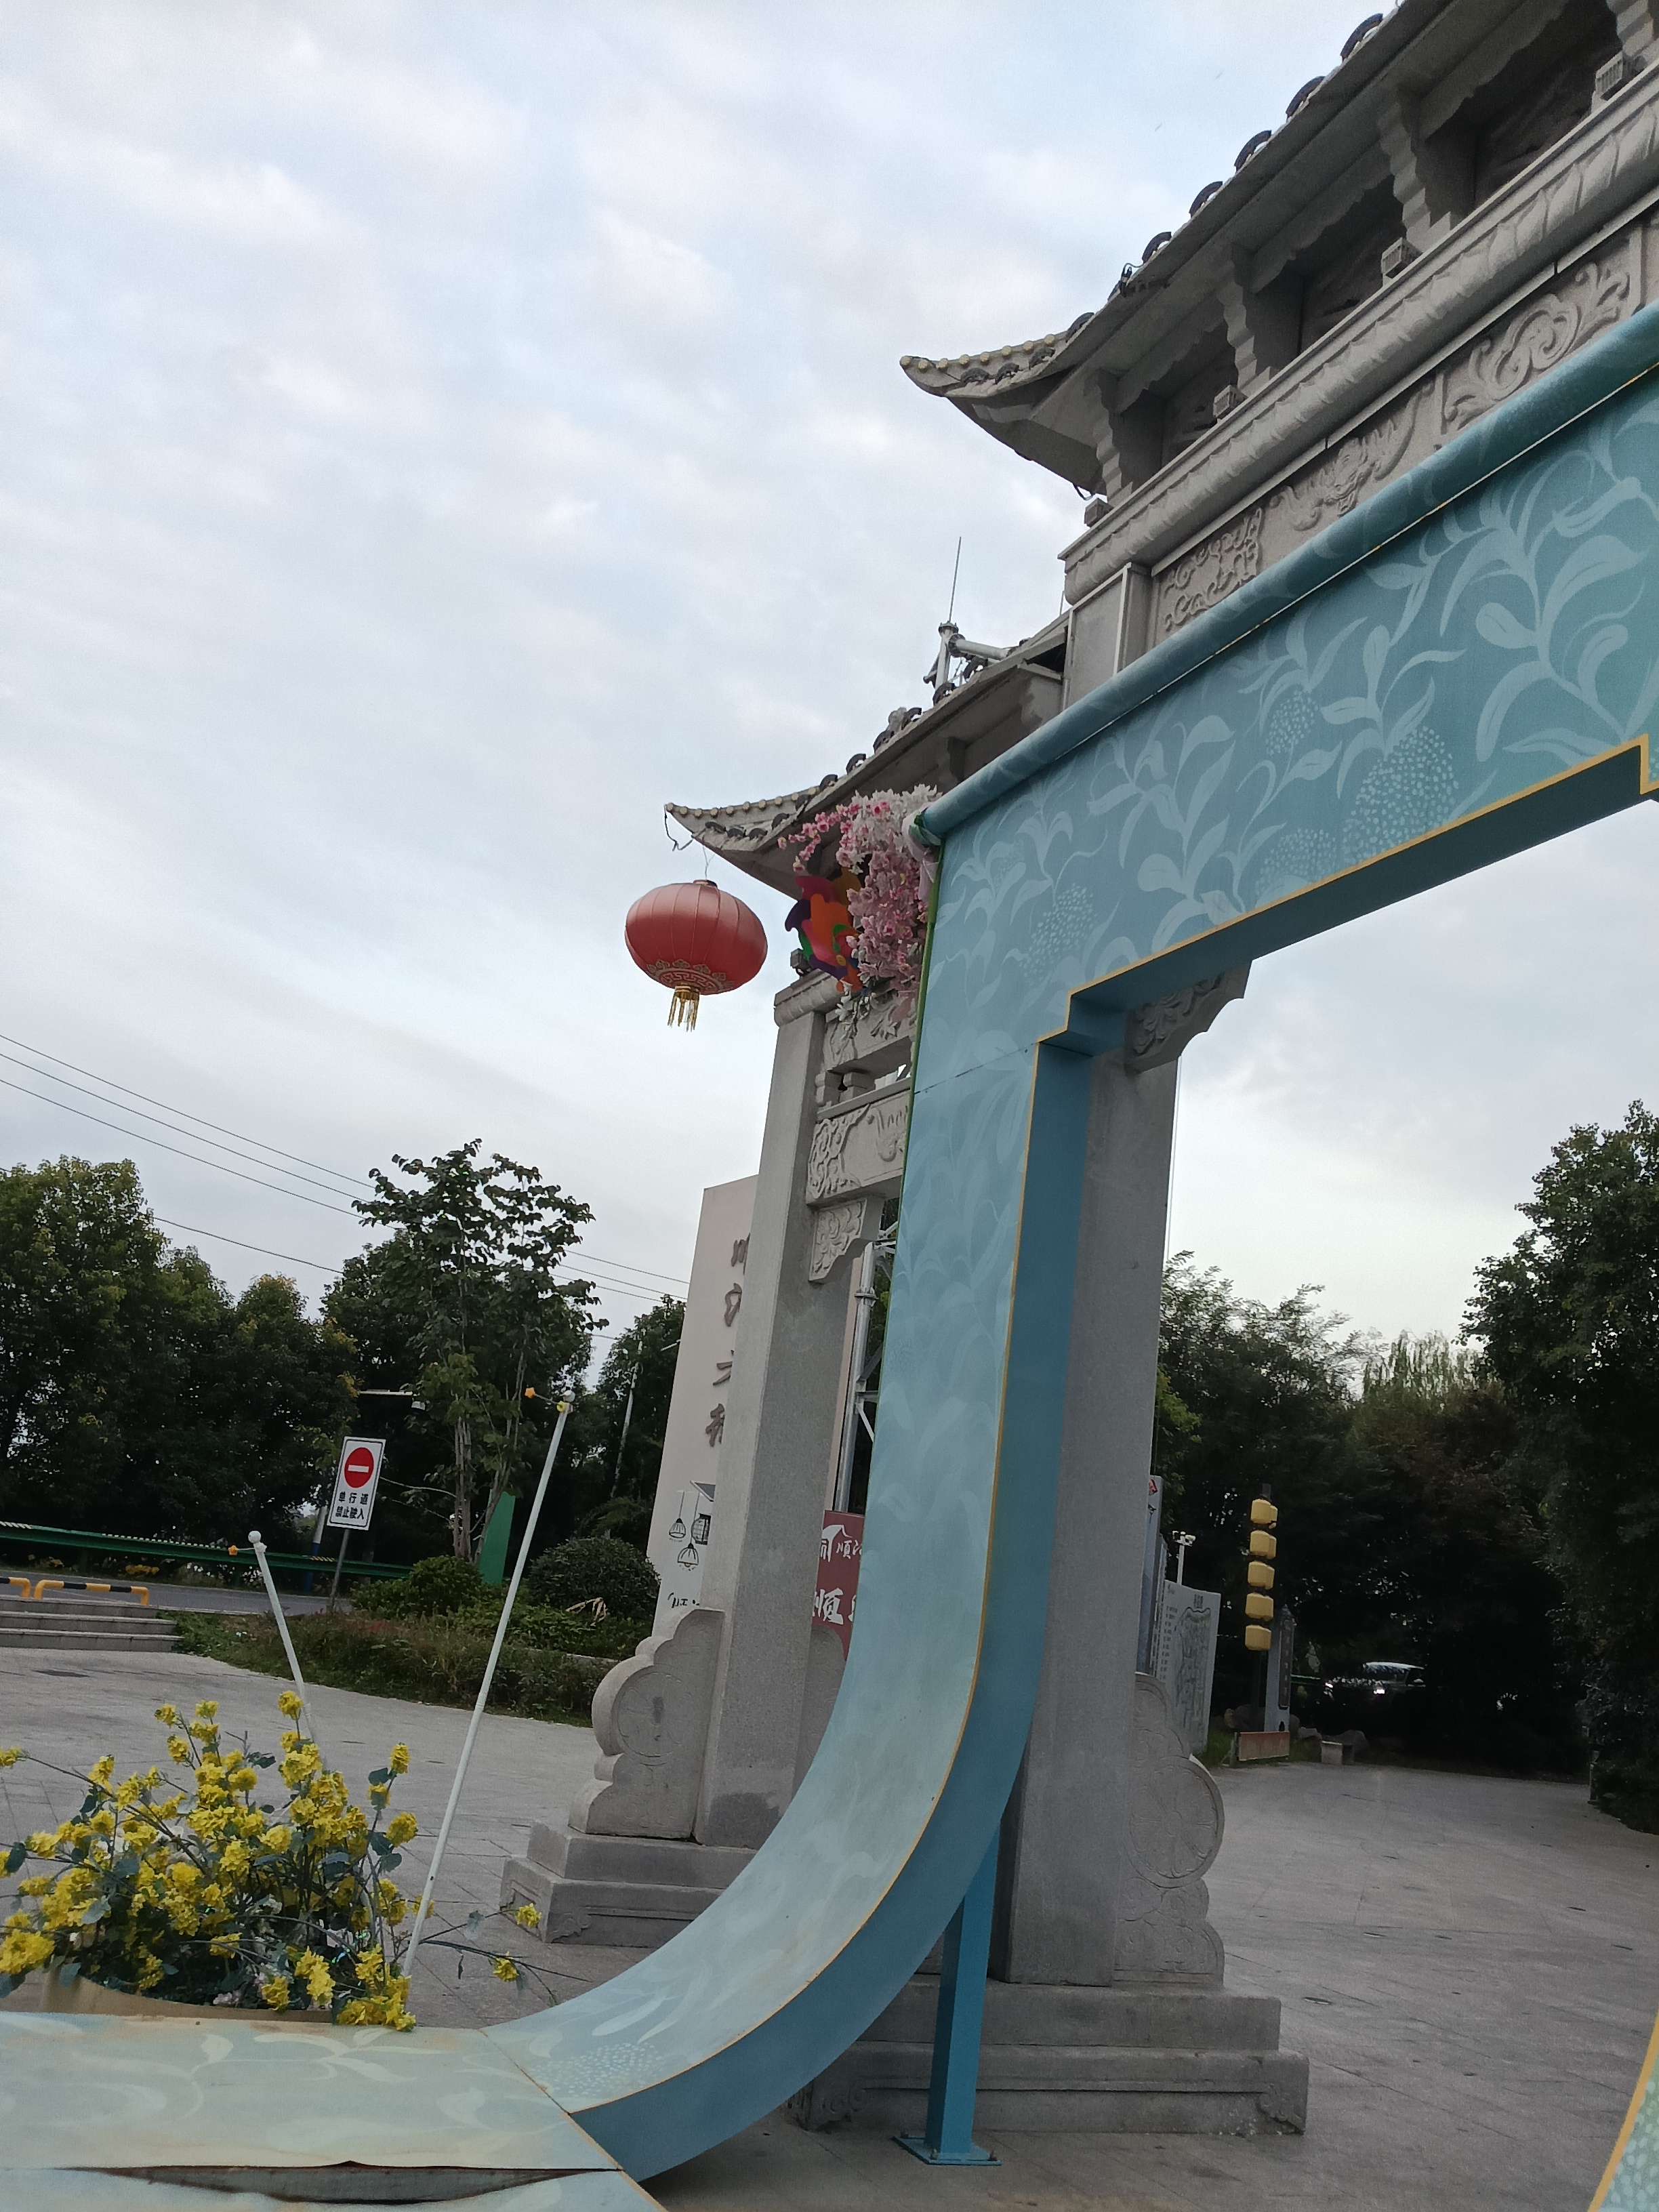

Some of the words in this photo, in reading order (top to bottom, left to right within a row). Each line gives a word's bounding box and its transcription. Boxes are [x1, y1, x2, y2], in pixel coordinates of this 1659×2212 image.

[338, 1492, 369, 1505] 单行道
[335, 1506, 365, 1520] 禁止驶入
